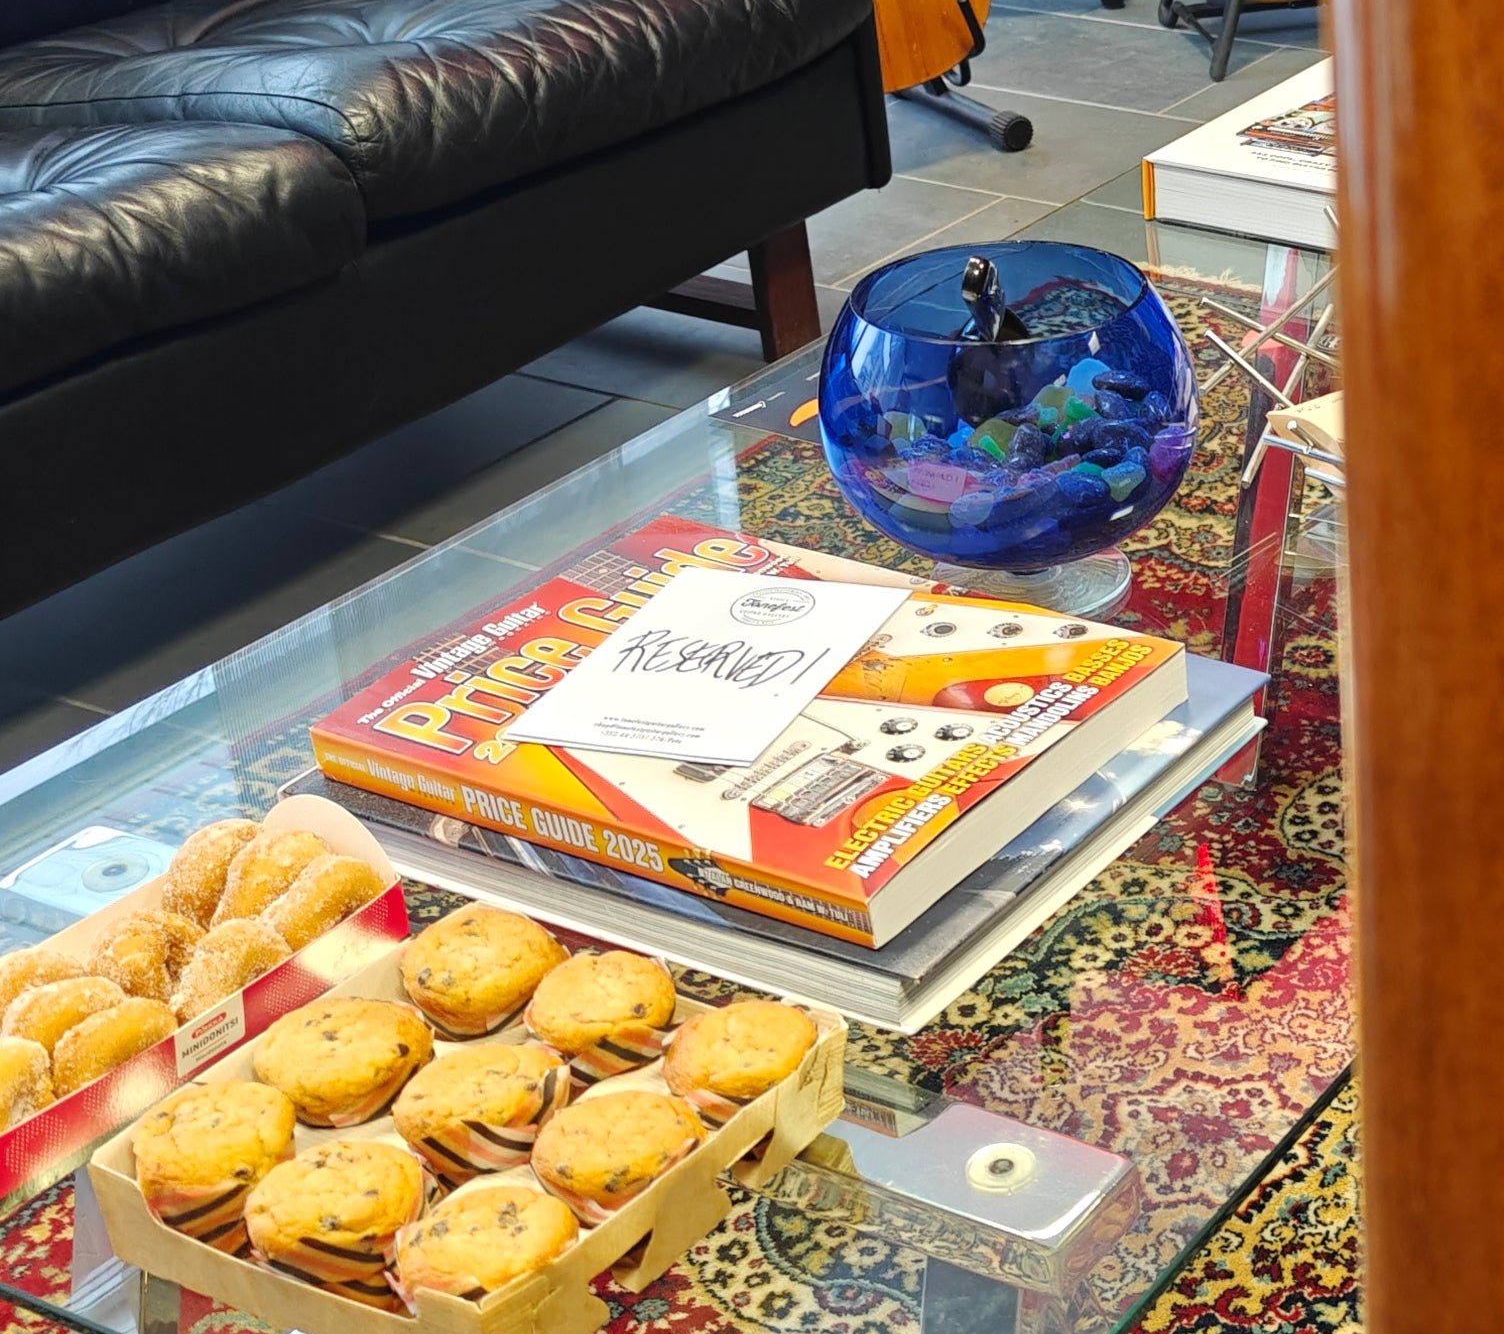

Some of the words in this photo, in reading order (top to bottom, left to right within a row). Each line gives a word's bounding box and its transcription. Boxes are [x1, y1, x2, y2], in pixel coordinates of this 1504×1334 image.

[357, 707, 384, 724] The
[381, 678, 426, 709] Official
[411, 633, 493, 680] Vintage
[482, 601, 547, 637] Guitar
[372, 637, 597, 755] Price
[612, 629, 831, 696] RESERVED!
[366, 758, 415, 791] Vintage
[417, 773, 456, 802] Guitar
[824, 795, 914, 871] ELECTRIC
[910, 742, 989, 801] GUITARS
[978, 681, 1073, 744] ACOUSTICS
[1062, 638, 1131, 684] BASSES
[850, 794, 952, 878] AMPLIFIERS
[944, 744, 1018, 796] EFFECTS
[1005, 684, 1099, 746] MANDOLINS
[1088, 644, 1153, 688] BANJOS
[460, 784, 528, 830] PRICE
[530, 807, 600, 853] GUIDE
[602, 829, 664, 873] 2025
[733, 878, 785, 903] GREENWOOD
[182, 1017, 239, 1058] MINIDONITSI
